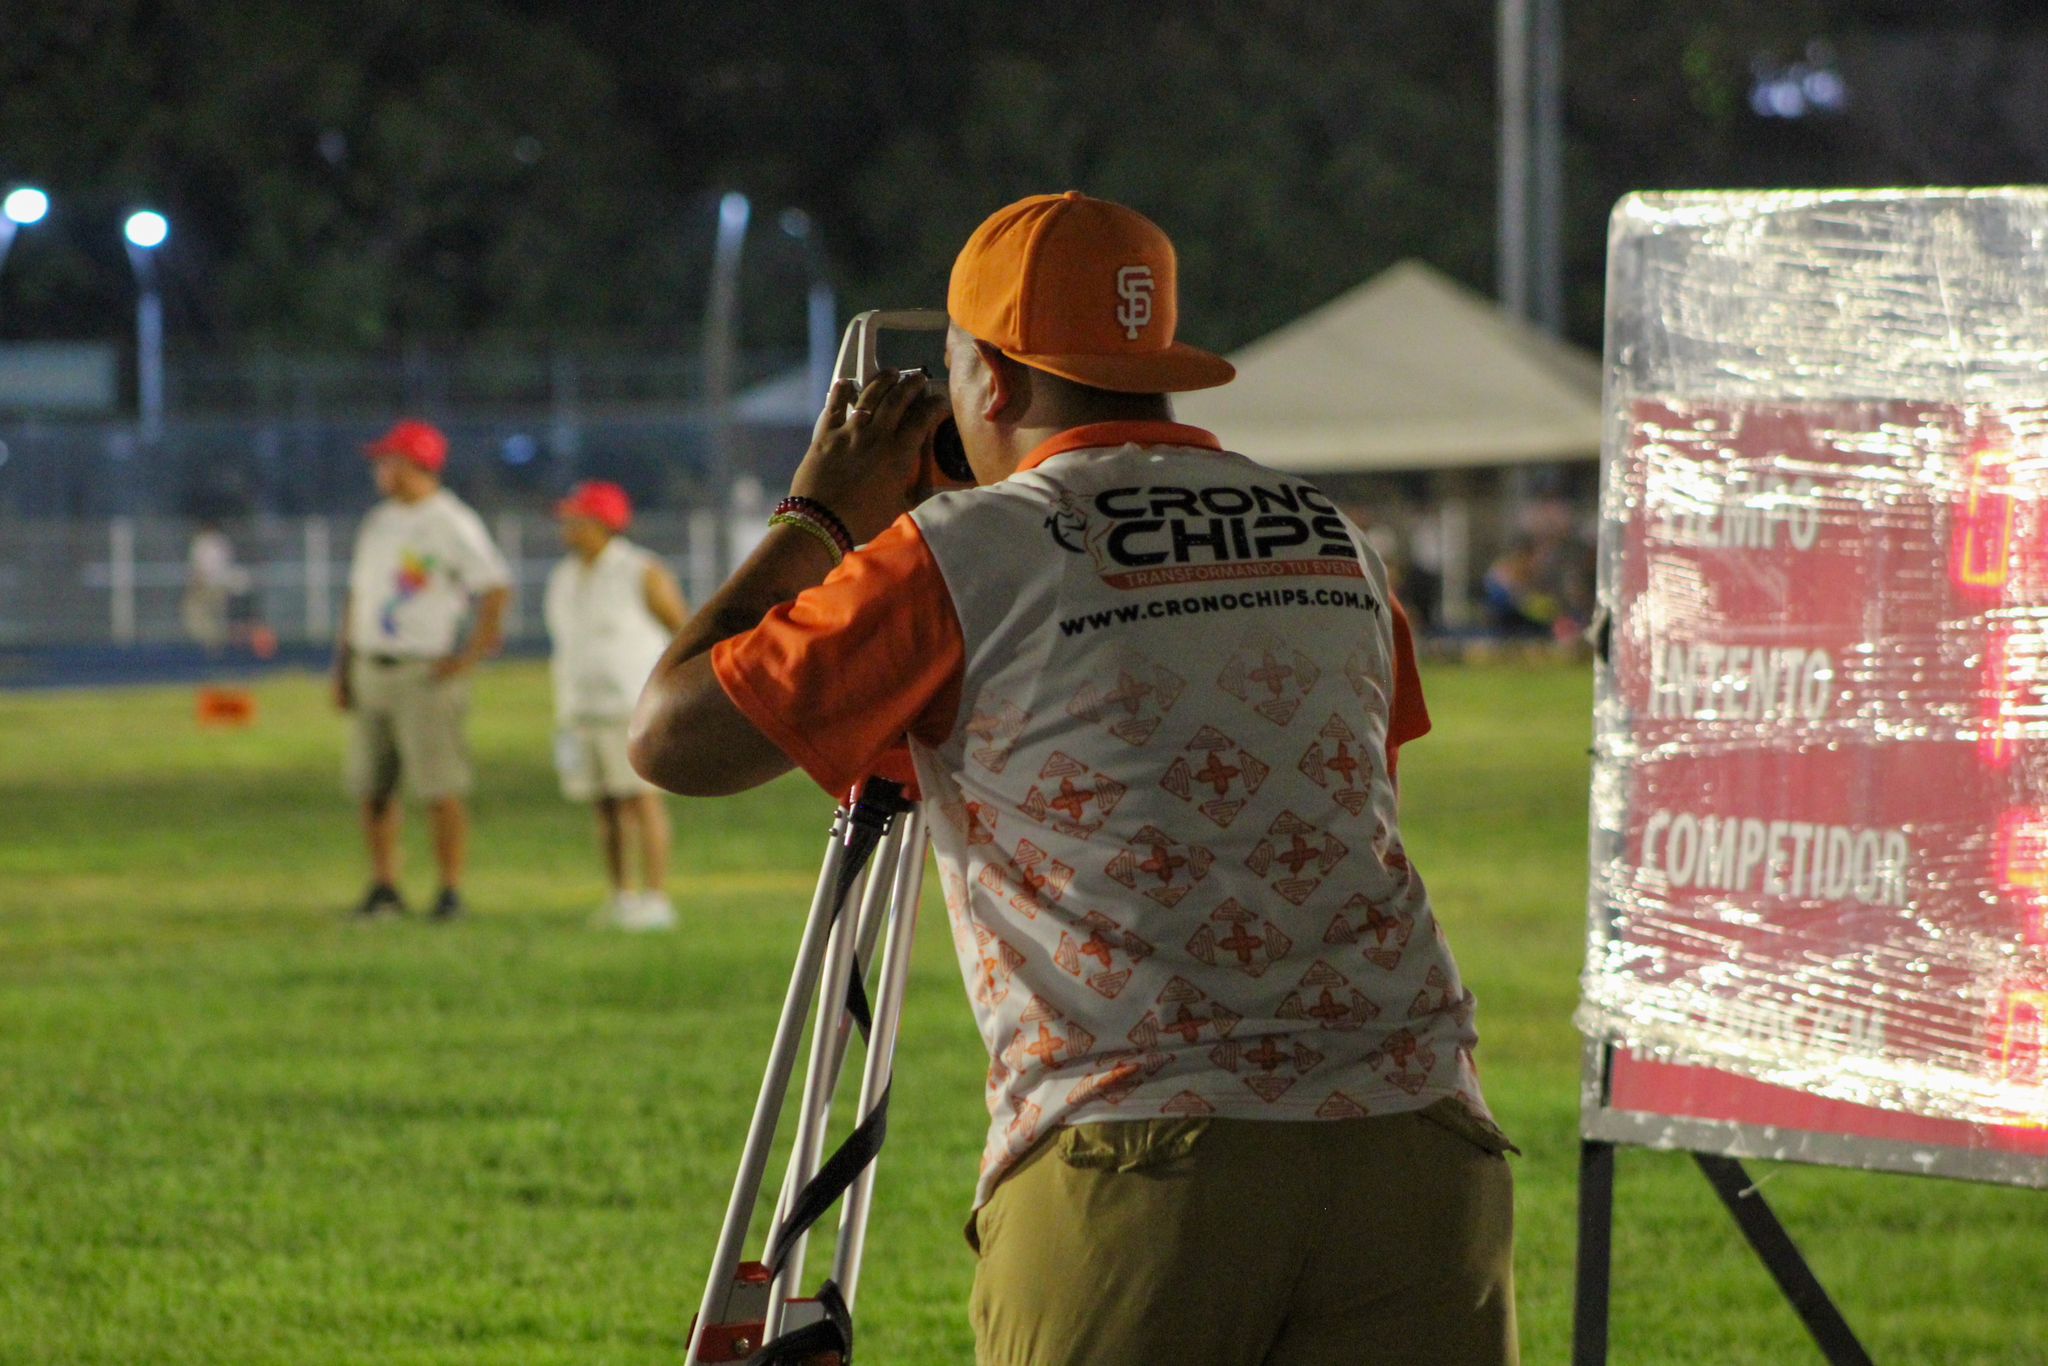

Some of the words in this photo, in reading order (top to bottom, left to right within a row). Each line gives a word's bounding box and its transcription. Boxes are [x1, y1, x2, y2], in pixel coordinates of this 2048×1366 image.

[1106, 514, 1359, 568] CHIPS
[1124, 560, 1284, 588] TRANSFORMANDO
[1287, 560, 1309, 576] TU
[1640, 810, 1911, 908] COMPETIDOR
